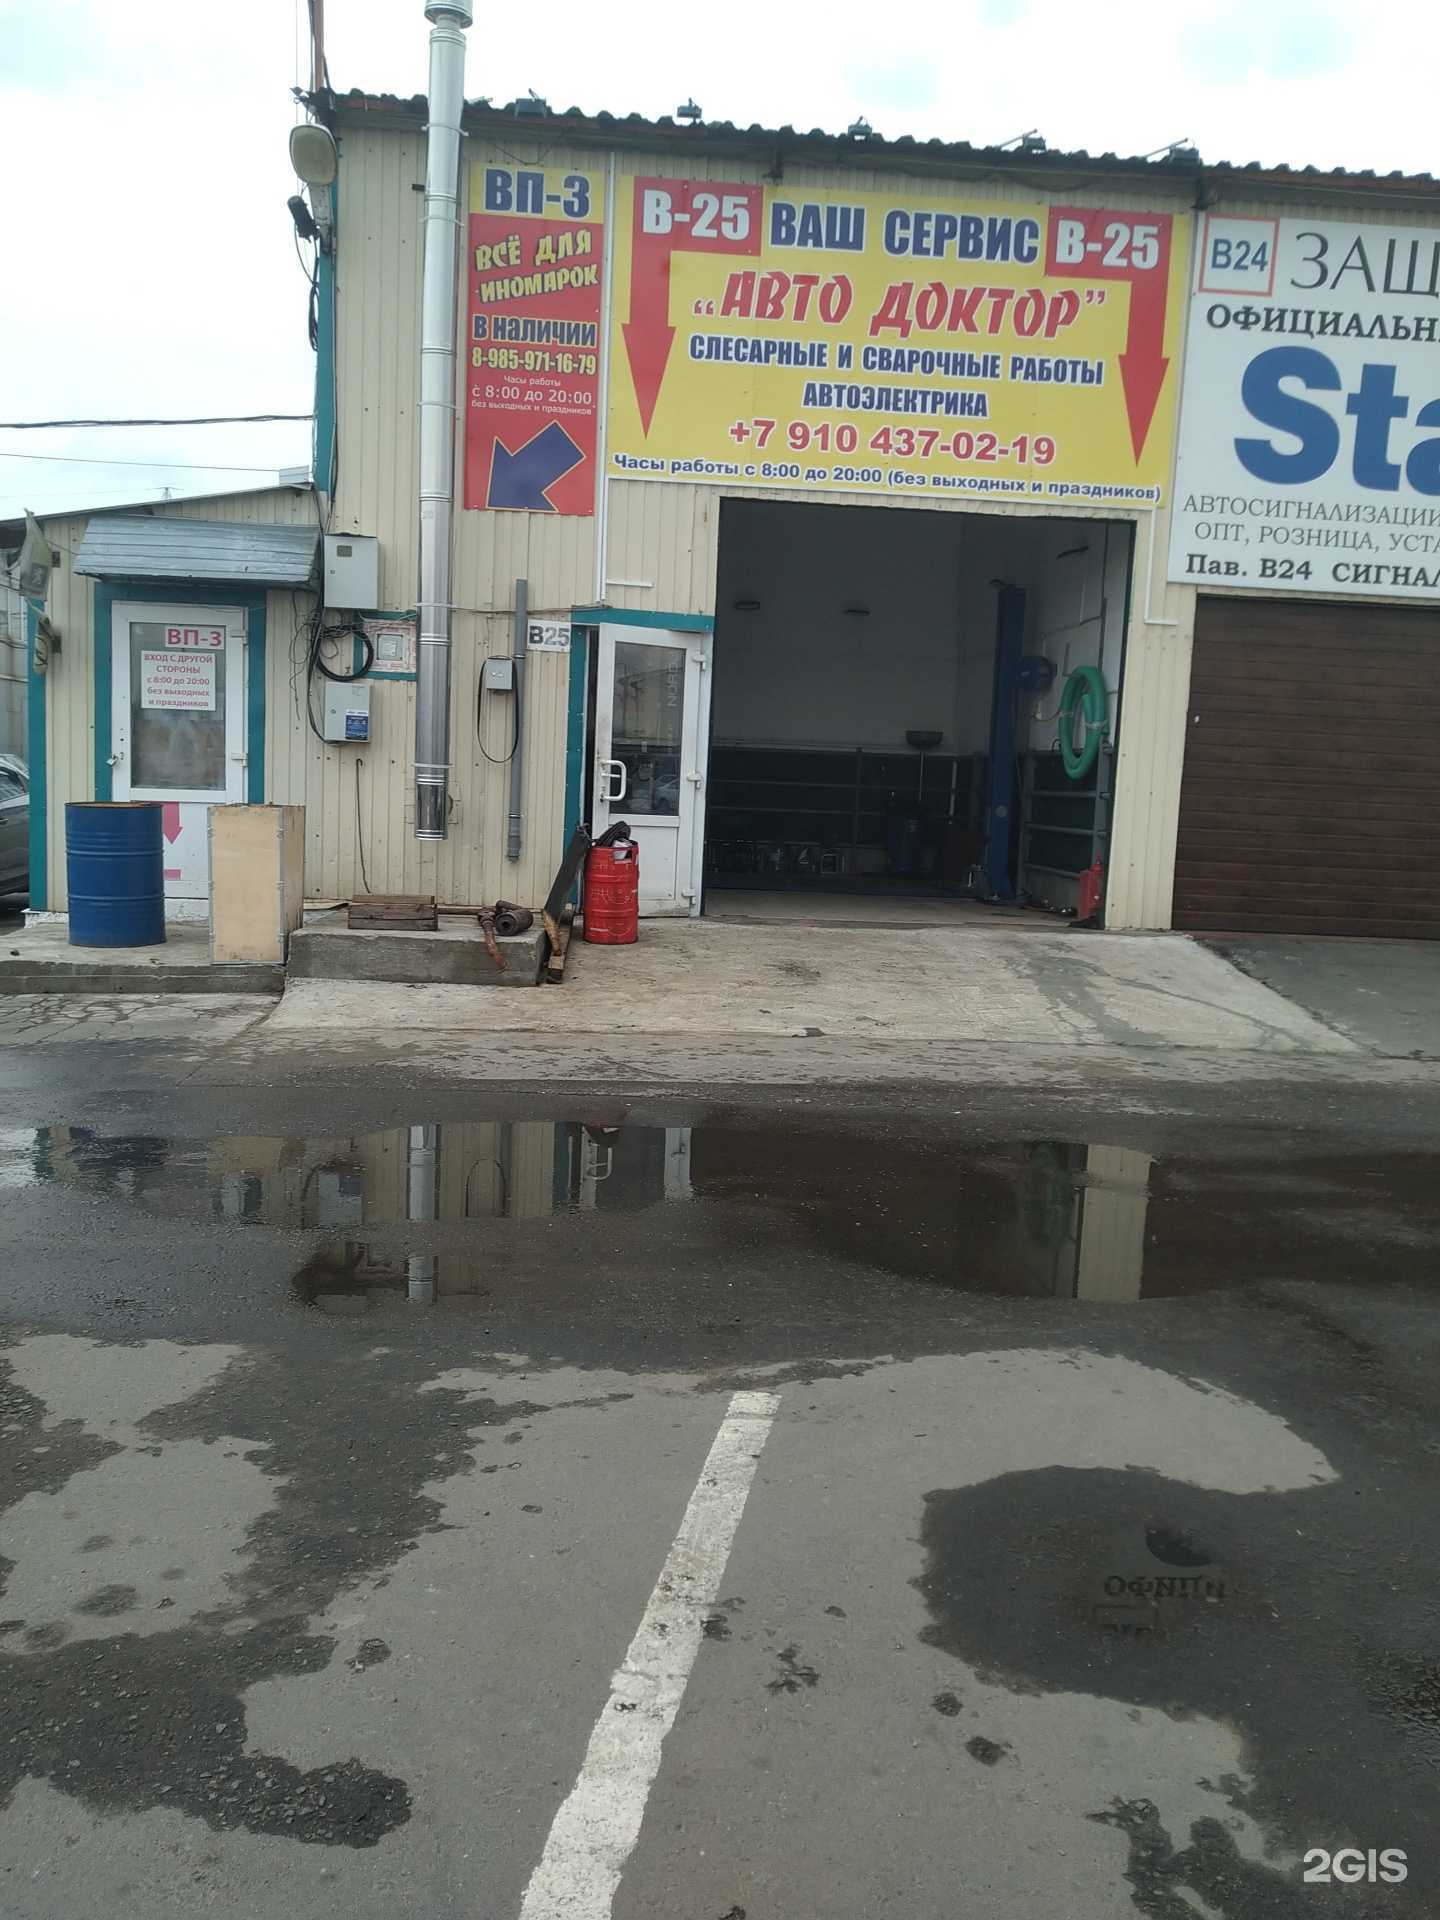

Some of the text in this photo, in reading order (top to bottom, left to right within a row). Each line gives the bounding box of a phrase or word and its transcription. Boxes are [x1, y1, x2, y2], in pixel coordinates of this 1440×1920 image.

[485, 168, 590, 218] ВП-3
[643, 189, 750, 240] В-25
[771, 202, 1040, 264] ВАШ СЕРВИС
[1055, 219, 1160, 270] В-25
[475, 228, 592, 271] ВСЁ ДЛЯ
[1211, 238, 1268, 272] В24
[1290, 232, 1440, 299] ЗАЩ
[480, 264, 598, 303] ИНОМАРОК
[473, 315, 597, 347] В наличии
[1206, 304, 1440, 344] ОФИЦИАЛЬН
[472, 346, 597, 375] 8-985-971-16-79
[690, 334, 1104, 385] СЛЕСАРНЫЕ И СВАРОЧНЫЕ РАБОТЫ
[485, 385, 520, 399] 8:00
[524, 390, 543, 402] до
[549, 389, 592, 404] 20:00
[530, 377, 561, 387] работы
[488, 401, 531, 411] выходных
[542, 405, 592, 415] праздников
[803, 382, 988, 418] АВТОЭЛЕКТРИКА
[730, 420, 1055, 465] +7 910 437-02-19
[614, 454, 1161, 501] Часы работы с 8:00 до 20:00 (без выходных и праздников)
[1195, 522, 1250, 545] ОПТ,
[1258, 526, 1380, 553] РОЗНИЦА,
[1186, 554, 1247, 577] Пав.
[1258, 558, 1313, 580] В24
[167, 628, 222, 647] ВП-3
[529, 625, 570, 647] В25
[144, 654, 168, 662] ВХОД
[177, 655, 213, 664] ДРУГОЙ
[156, 665, 201, 674] СТОРОНЫ
[147, 687, 209, 697] без выходных
[186, 677, 209, 686] 20:00
[155, 699, 208, 707] праздников
